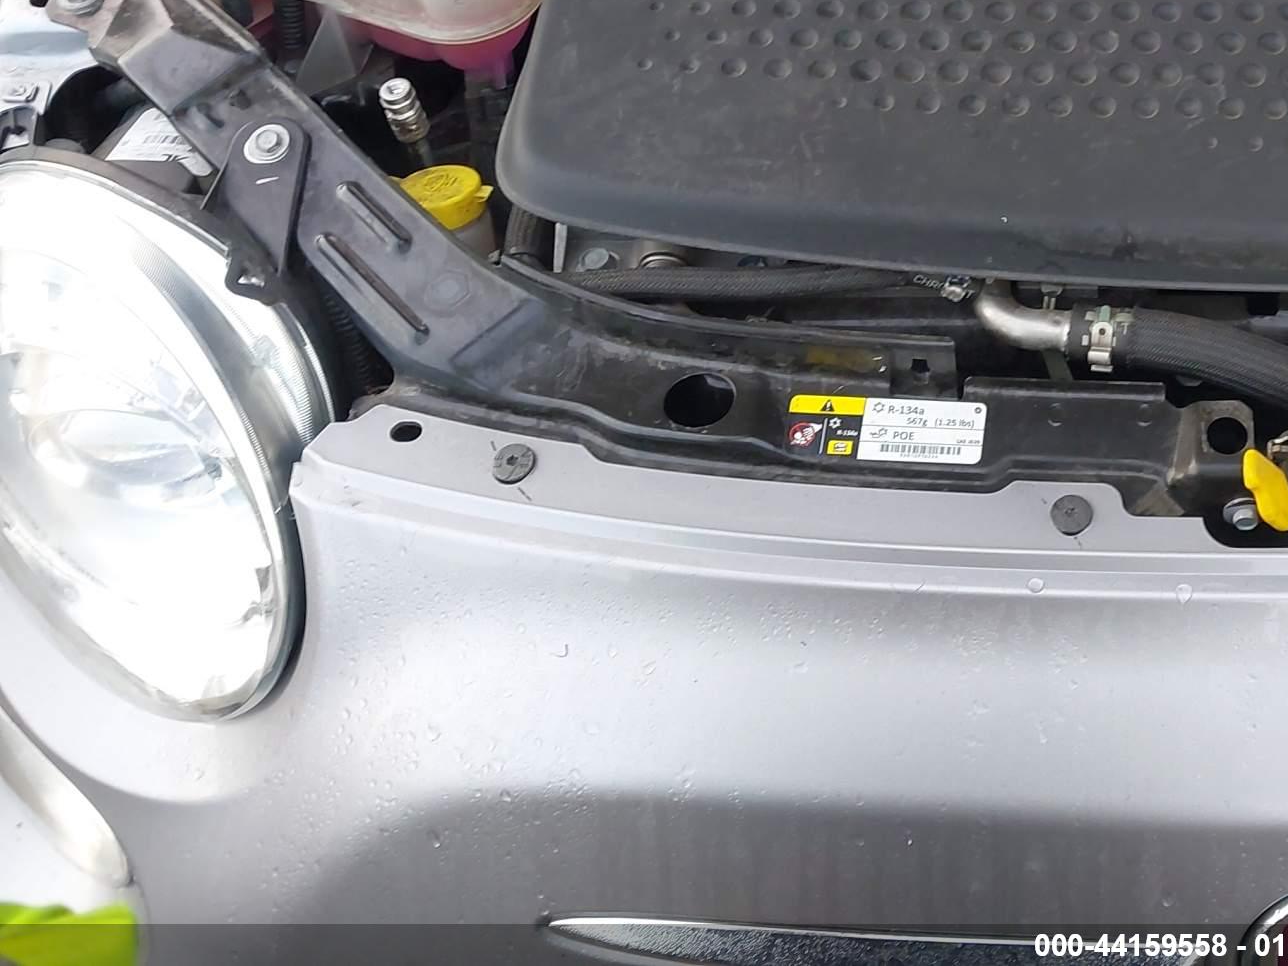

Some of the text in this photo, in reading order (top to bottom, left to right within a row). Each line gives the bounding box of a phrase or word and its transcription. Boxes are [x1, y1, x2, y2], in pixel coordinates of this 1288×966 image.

[887, 404, 925, 416] R-134a
[934, 417, 957, 427] (1.25
[959, 418, 975, 429] lbs)
[892, 430, 916, 441] POE
